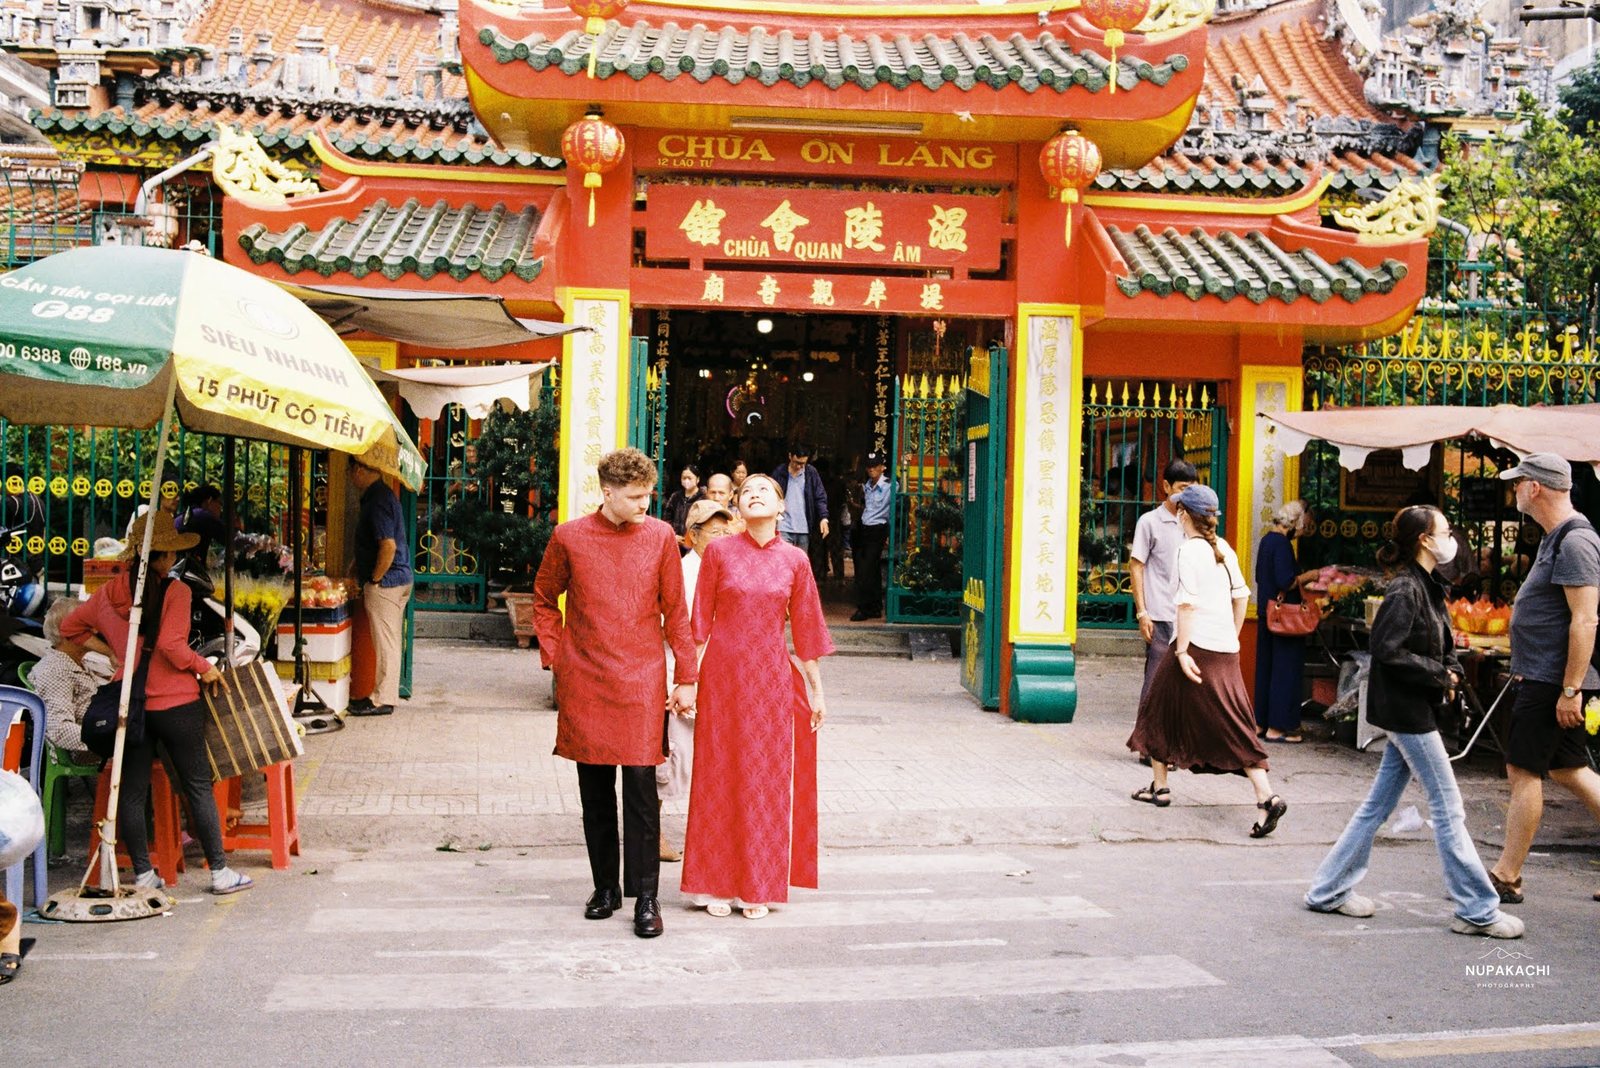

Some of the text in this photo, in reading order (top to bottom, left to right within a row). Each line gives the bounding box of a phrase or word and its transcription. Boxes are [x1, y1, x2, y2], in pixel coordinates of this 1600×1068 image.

[658, 134, 775, 161] CHÙA
[657, 158, 668, 166] 12
[723, 235, 921, 262] CHÙA QUAN ÂM
[31, 300, 115, 323] F88
[21, 346, 61, 364] 6388
[95, 355, 148, 375] f88.vn
[200, 324, 348, 387] SIÊU NHANH
[197, 375, 365, 442] 15 PHÚT CÓ TIỀN
